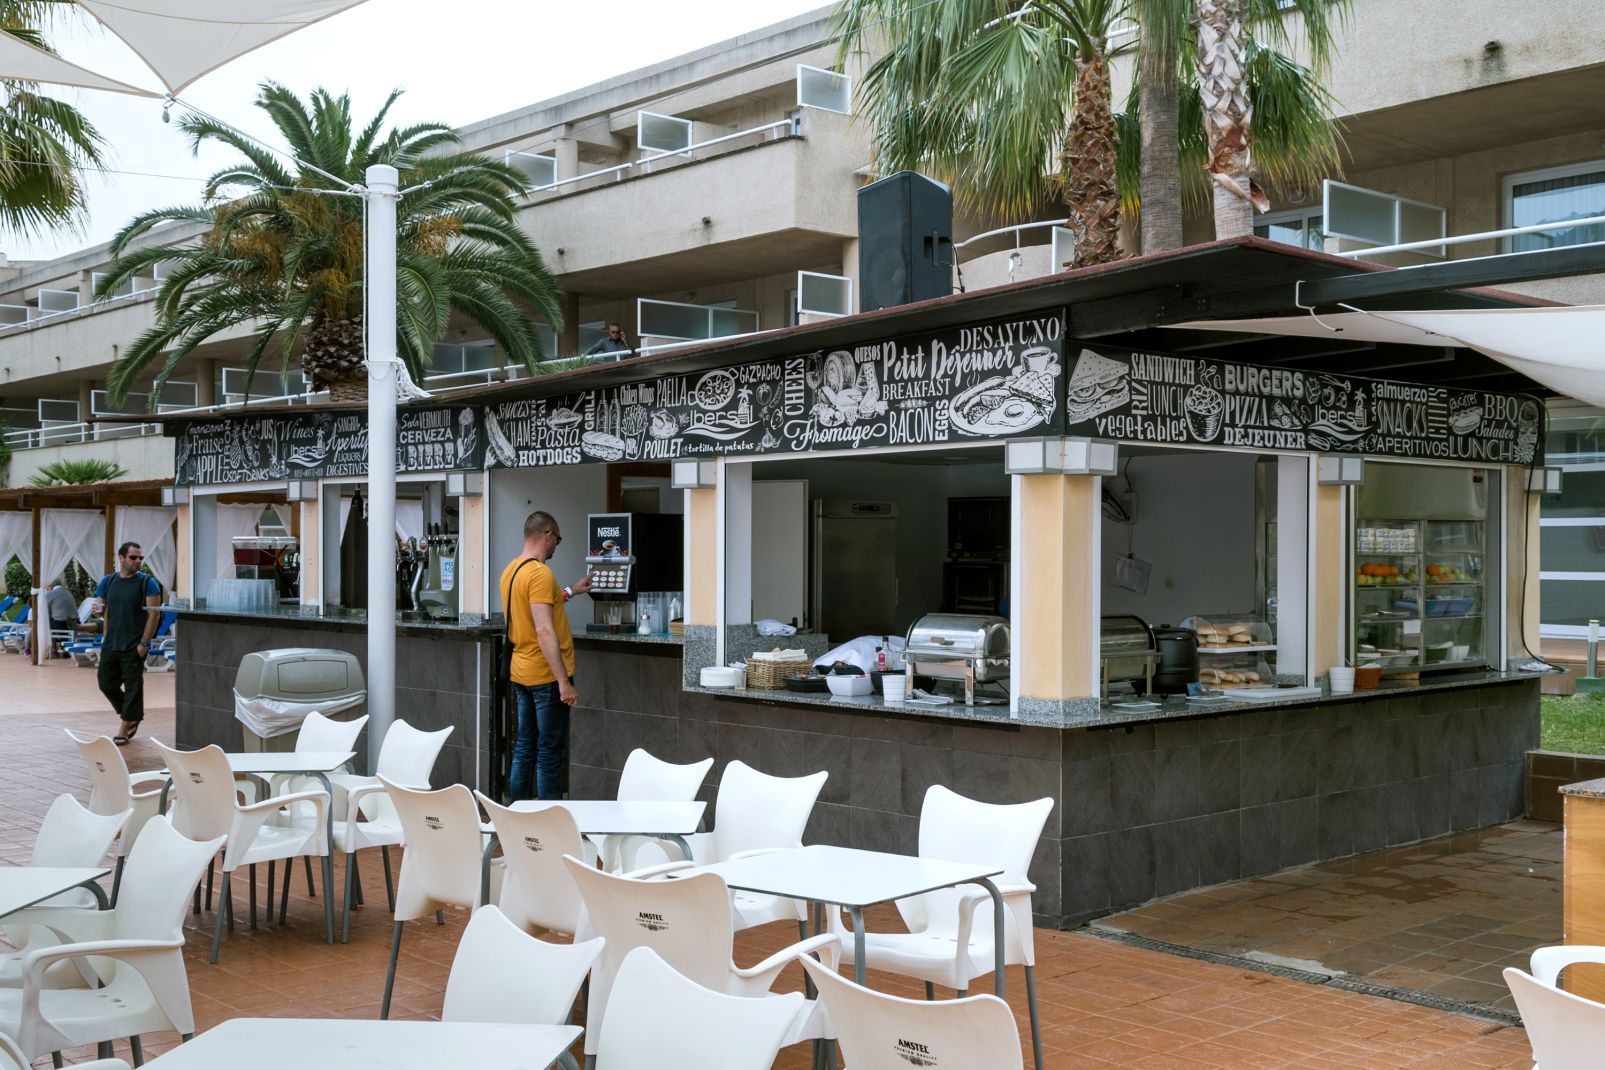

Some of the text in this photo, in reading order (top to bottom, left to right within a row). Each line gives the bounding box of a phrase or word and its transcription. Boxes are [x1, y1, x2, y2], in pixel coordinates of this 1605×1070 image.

[960, 317, 1060, 352] DESAYUNO
[854, 344, 881, 364] QUESOS
[883, 339, 1015, 387] Petit Déjeuner
[739, 364, 781, 383] GAZPACHO
[1131, 353, 1195, 385] SANDWICH
[1224, 364, 1304, 398] BURGERS
[656, 377, 687, 408] PAELLA
[882, 378, 951, 401] BREAKFAST
[1131, 381, 1148, 415] RIZ
[1148, 383, 1184, 417] LUNCH
[1377, 381, 1428, 402] almuerzo
[419, 409, 451, 429] VERMOUTH
[496, 400, 531, 420] SAUCES
[584, 390, 596, 431] GRILL
[690, 404, 753, 426] Ibersl
[935, 399, 949, 441] EGGS
[1225, 394, 1269, 427] PIZZA
[1315, 405, 1367, 427] Ibersl
[1377, 400, 1428, 437] SNACKS
[1483, 394, 1518, 426] BBQ
[261, 419, 273, 440] JUS
[277, 417, 315, 441] Wines
[399, 427, 454, 444] CERVEZA
[510, 419, 531, 447] HAM
[535, 425, 581, 448] Pasta
[784, 419, 888, 451] Fromage
[889, 406, 934, 444] BACON
[1095, 415, 1187, 442] vegetables
[1476, 419, 1515, 440] Salades
[192, 433, 224, 454] Fraise
[222, 419, 232, 482] CITRON
[290, 442, 326, 457] Ibersl
[643, 438, 683, 459] POULET
[688, 440, 754, 454] tortilla de patatas
[1376, 436, 1514, 461] APERITIVOS LUNCH
[196, 454, 224, 484] APPLE
[518, 447, 582, 467] HOTDOGS
[639, 912, 663, 921] AMSTEL
[898, 1038, 930, 1054] AMSTEL
